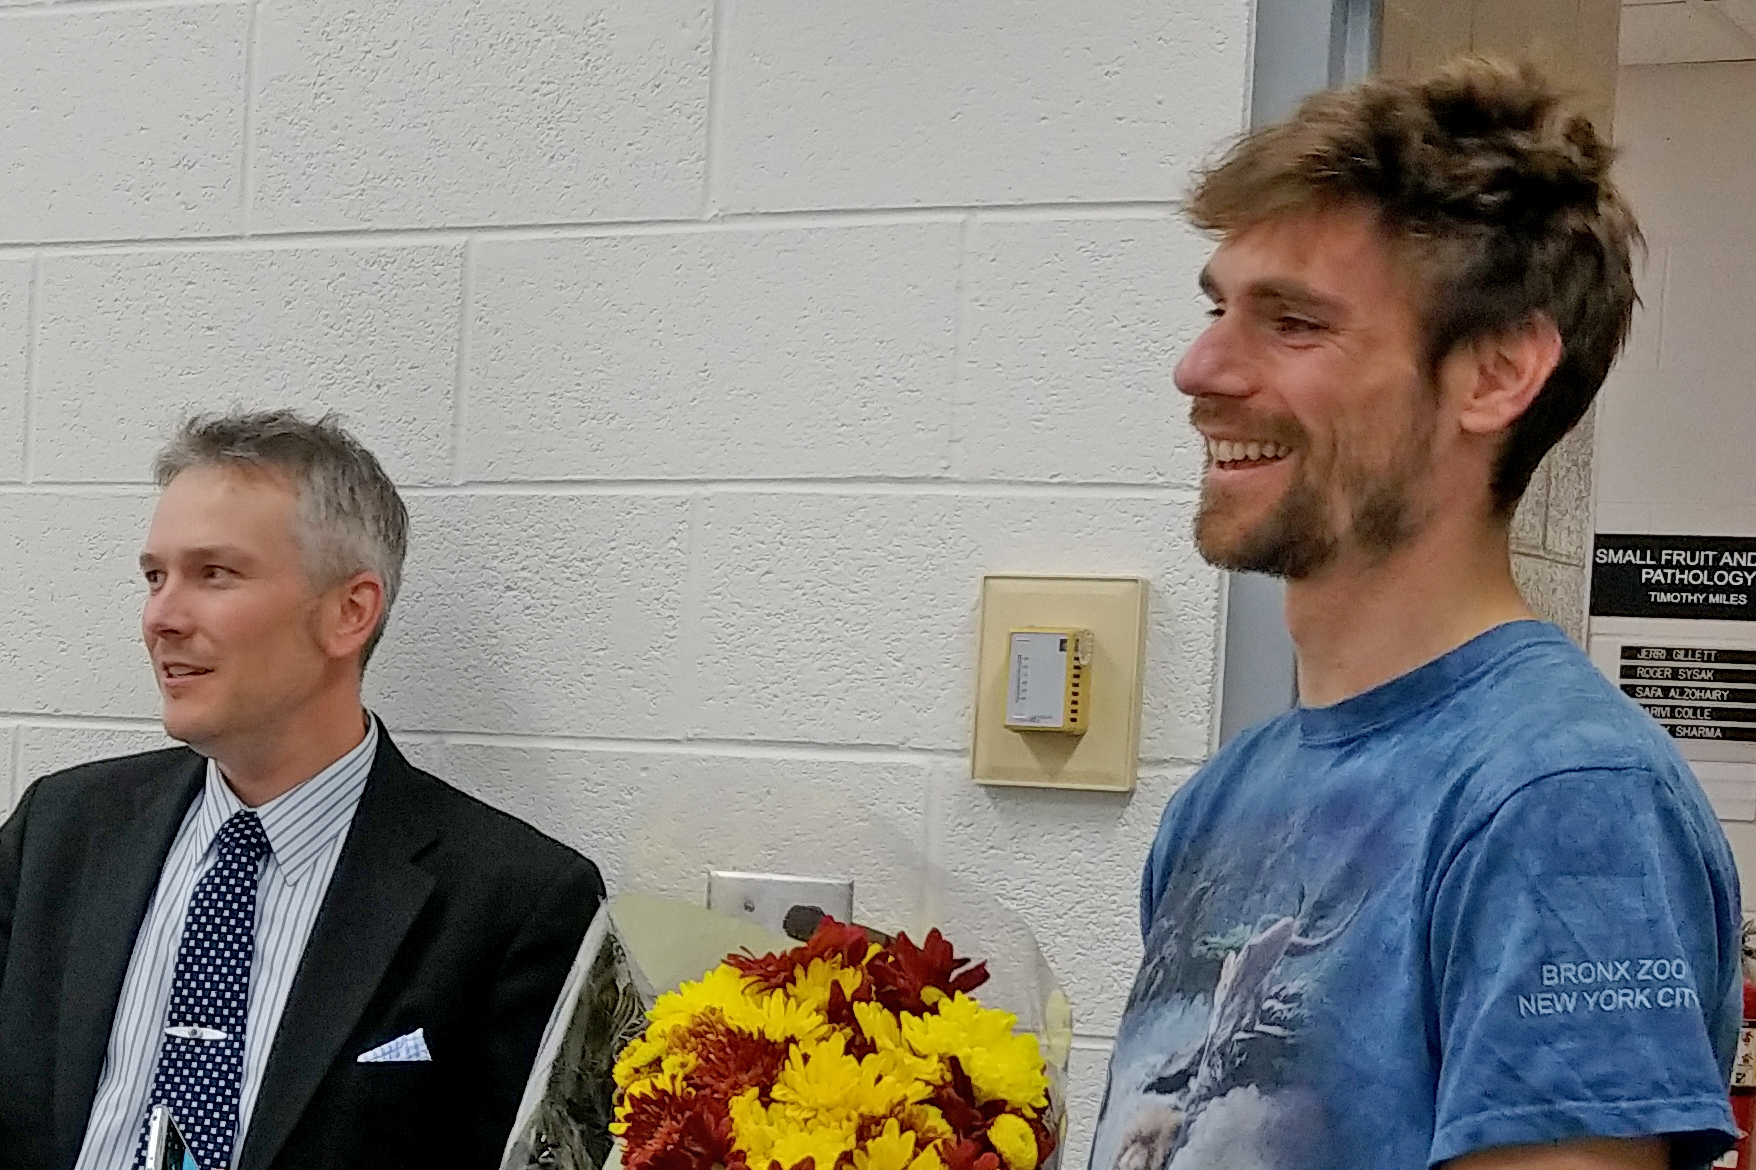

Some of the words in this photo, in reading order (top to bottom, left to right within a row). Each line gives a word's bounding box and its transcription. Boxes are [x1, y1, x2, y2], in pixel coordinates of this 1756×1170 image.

[1595, 549, 1656, 564] SMALL
[1661, 550, 1718, 566] FRUIT
[1642, 568, 1756, 586] PATHOLOGY
[1648, 591, 1707, 604] TIMOTHY
[1708, 593, 1748, 605] MILES
[1672, 649, 1717, 661] GILLETT
[1636, 667, 1672, 679] ROGER
[1678, 668, 1714, 680] SYSAK
[1635, 686, 1663, 698] SAFA
[1675, 707, 1712, 720] COLLE
[1675, 726, 1723, 738] SHARMA
[1541, 960, 1631, 986] BRONX
[1636, 958, 1688, 981] ZOO
[1518, 991, 1577, 1018] NEW
[1582, 988, 1652, 1012] YORK
